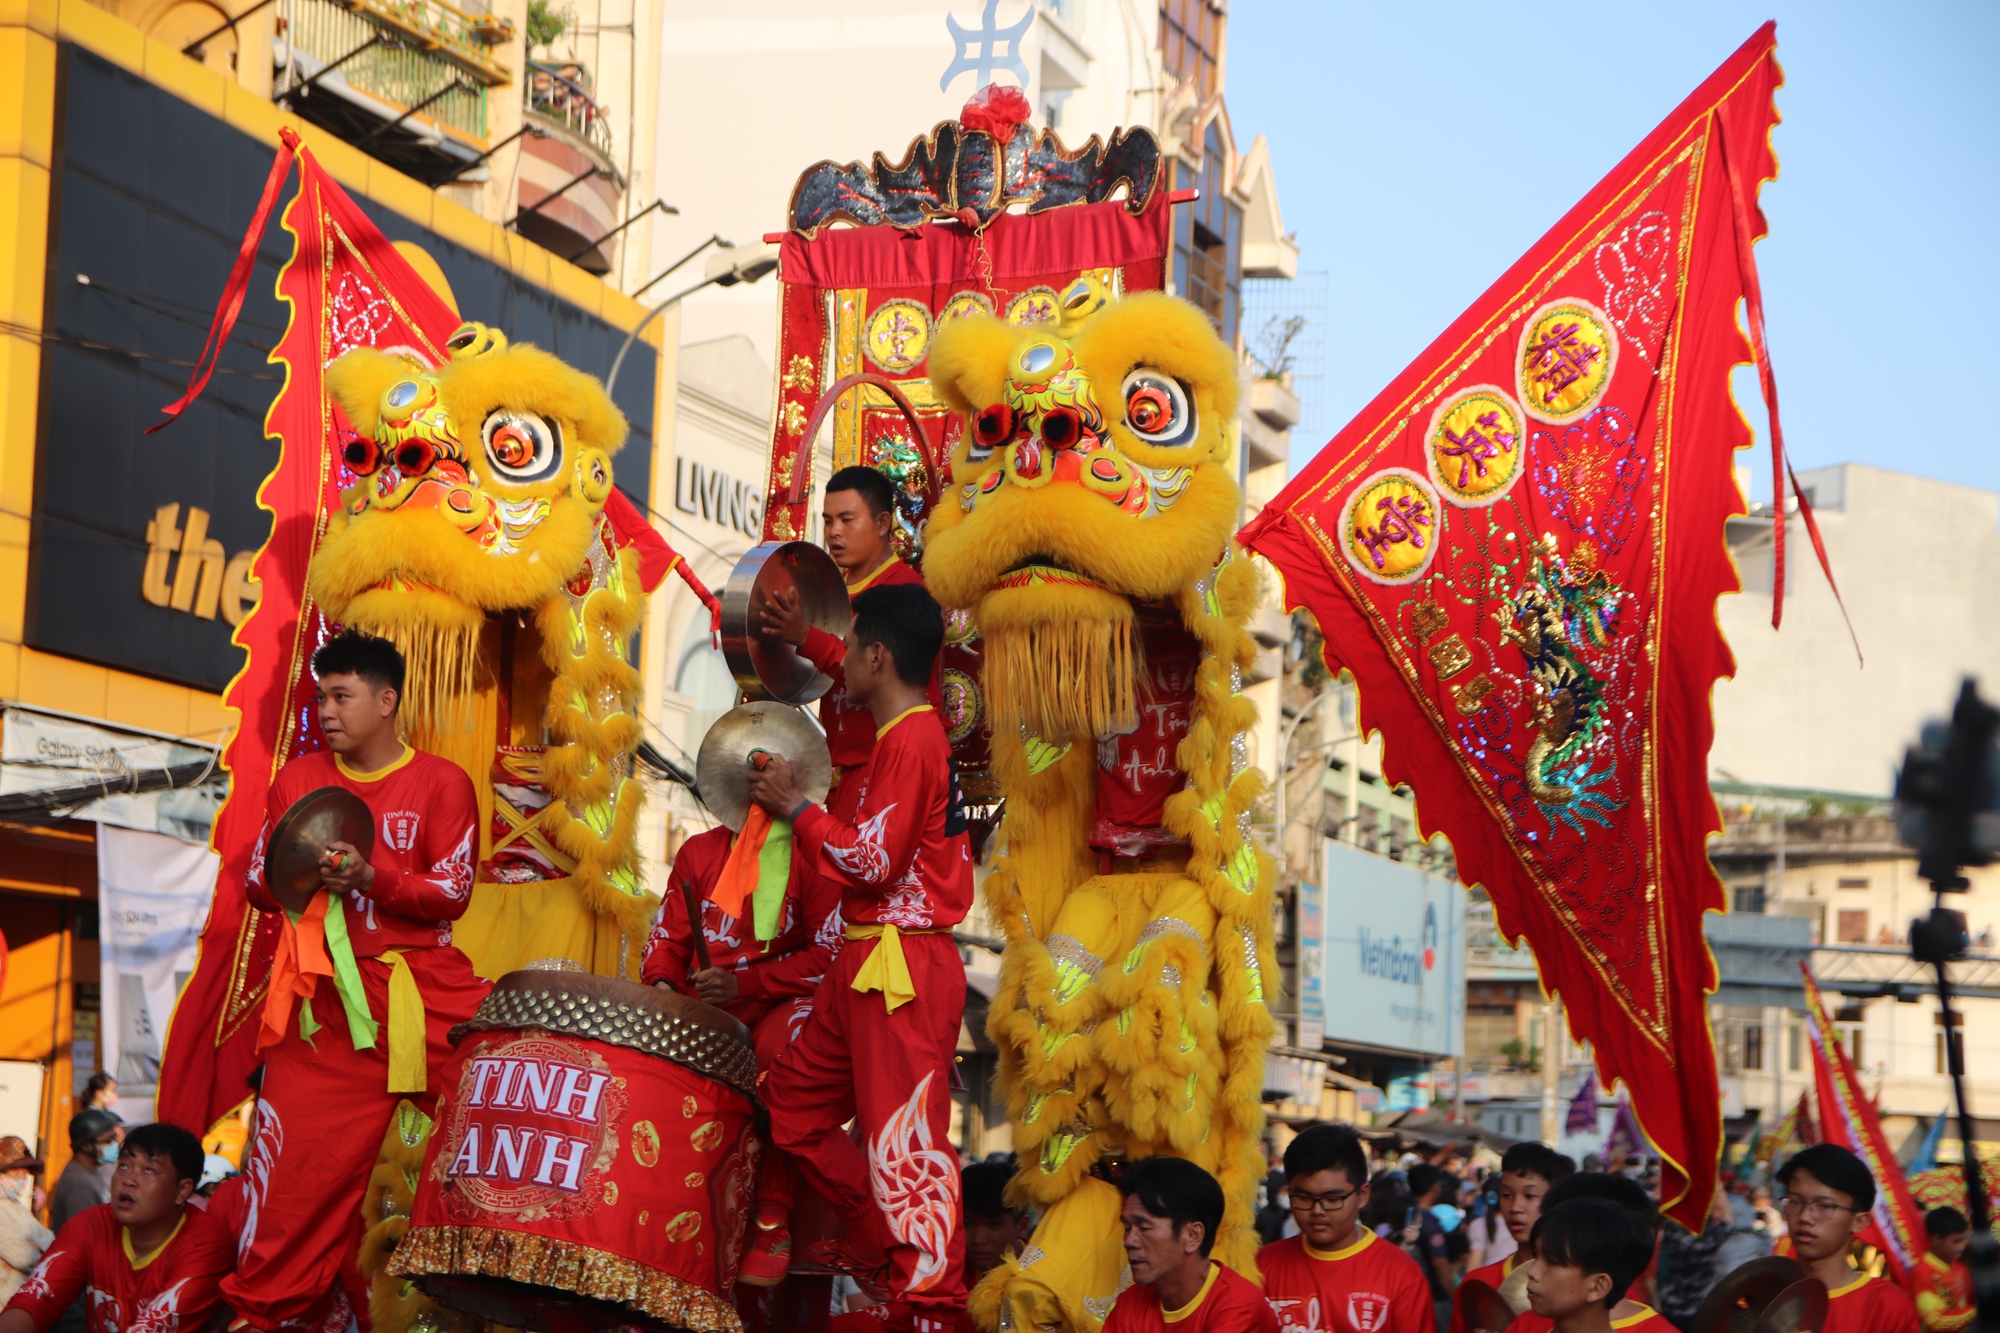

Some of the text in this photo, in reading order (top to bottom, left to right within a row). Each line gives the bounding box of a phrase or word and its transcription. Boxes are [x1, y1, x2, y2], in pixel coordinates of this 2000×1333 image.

[675, 456, 762, 539] LIVING
[142, 502, 263, 628] the
[1145, 701, 1194, 738] Tin
[36, 734, 80, 767] Galaxy
[1123, 746, 1178, 792] Anh
[386, 810, 420, 822] TINH ANH
[467, 1057, 611, 1124] TINH
[447, 1126, 591, 1192] ANH
